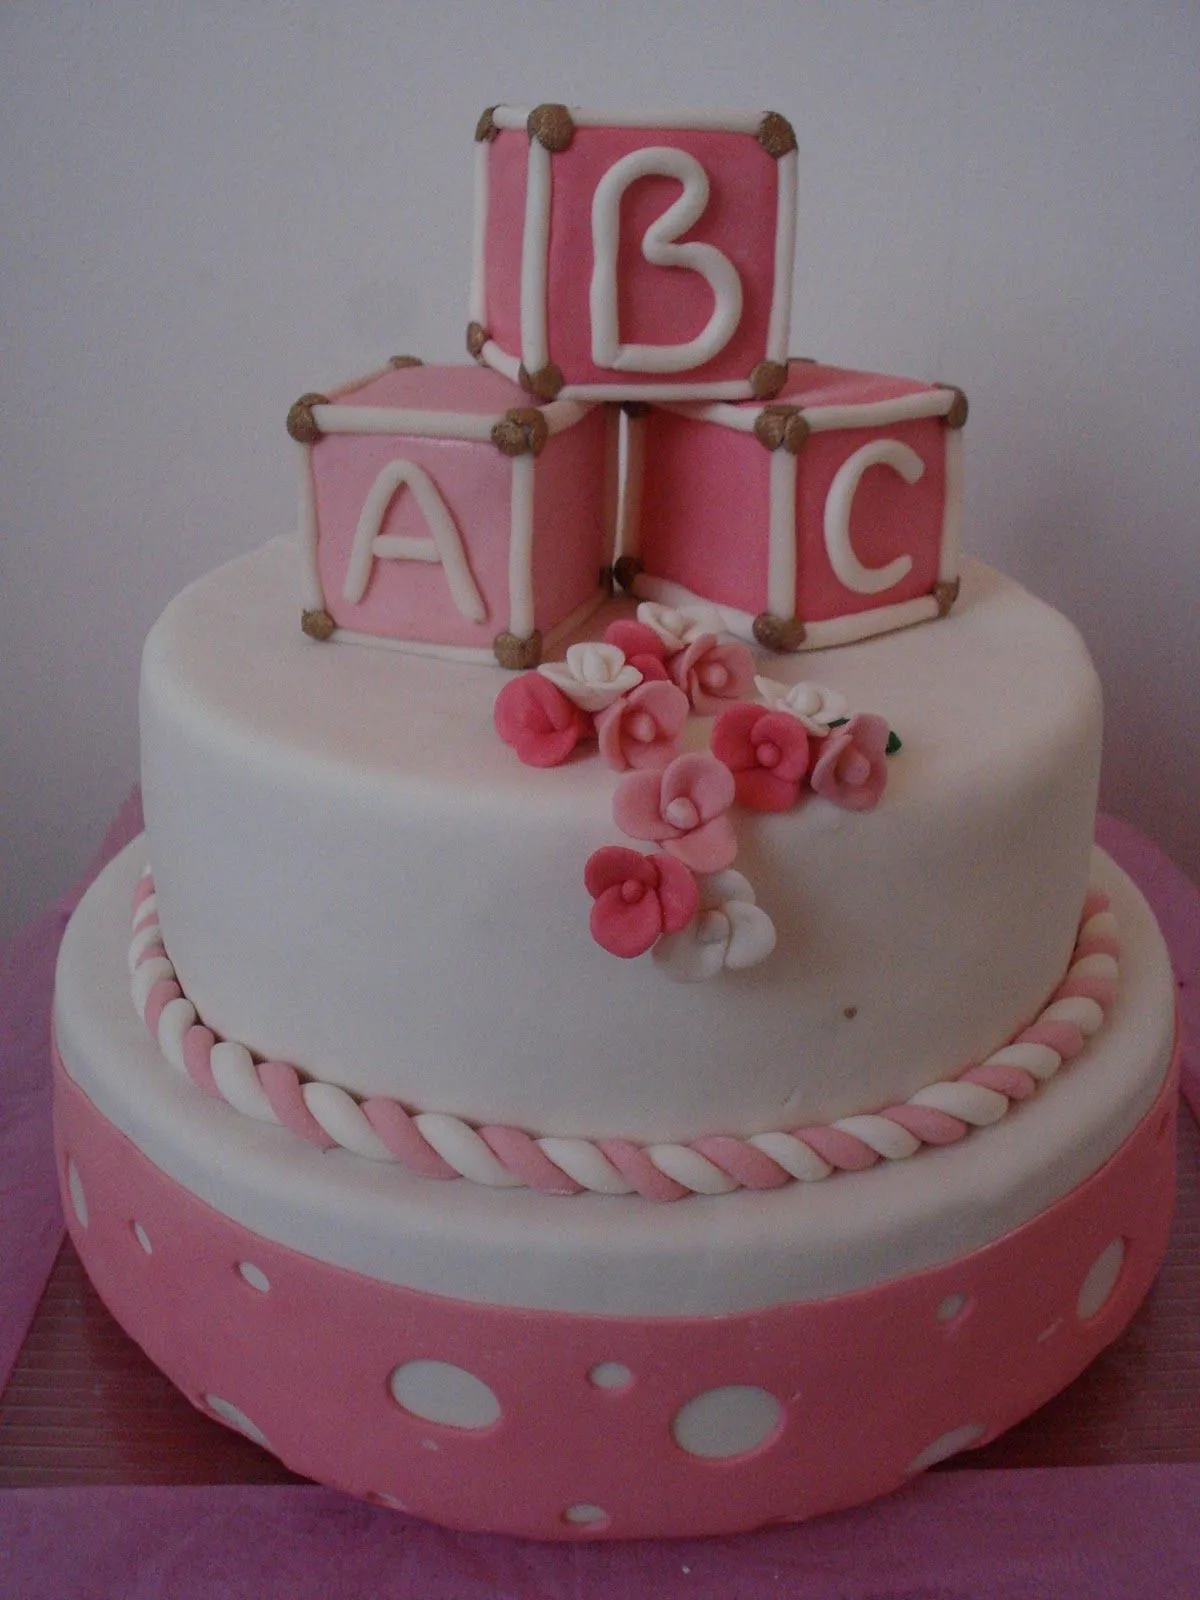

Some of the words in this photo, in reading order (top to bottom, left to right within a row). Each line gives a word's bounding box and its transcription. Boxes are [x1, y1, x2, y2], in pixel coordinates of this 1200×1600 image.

[589, 145, 743, 373] B
[342, 459, 488, 624] A
[823, 438, 926, 594] C
